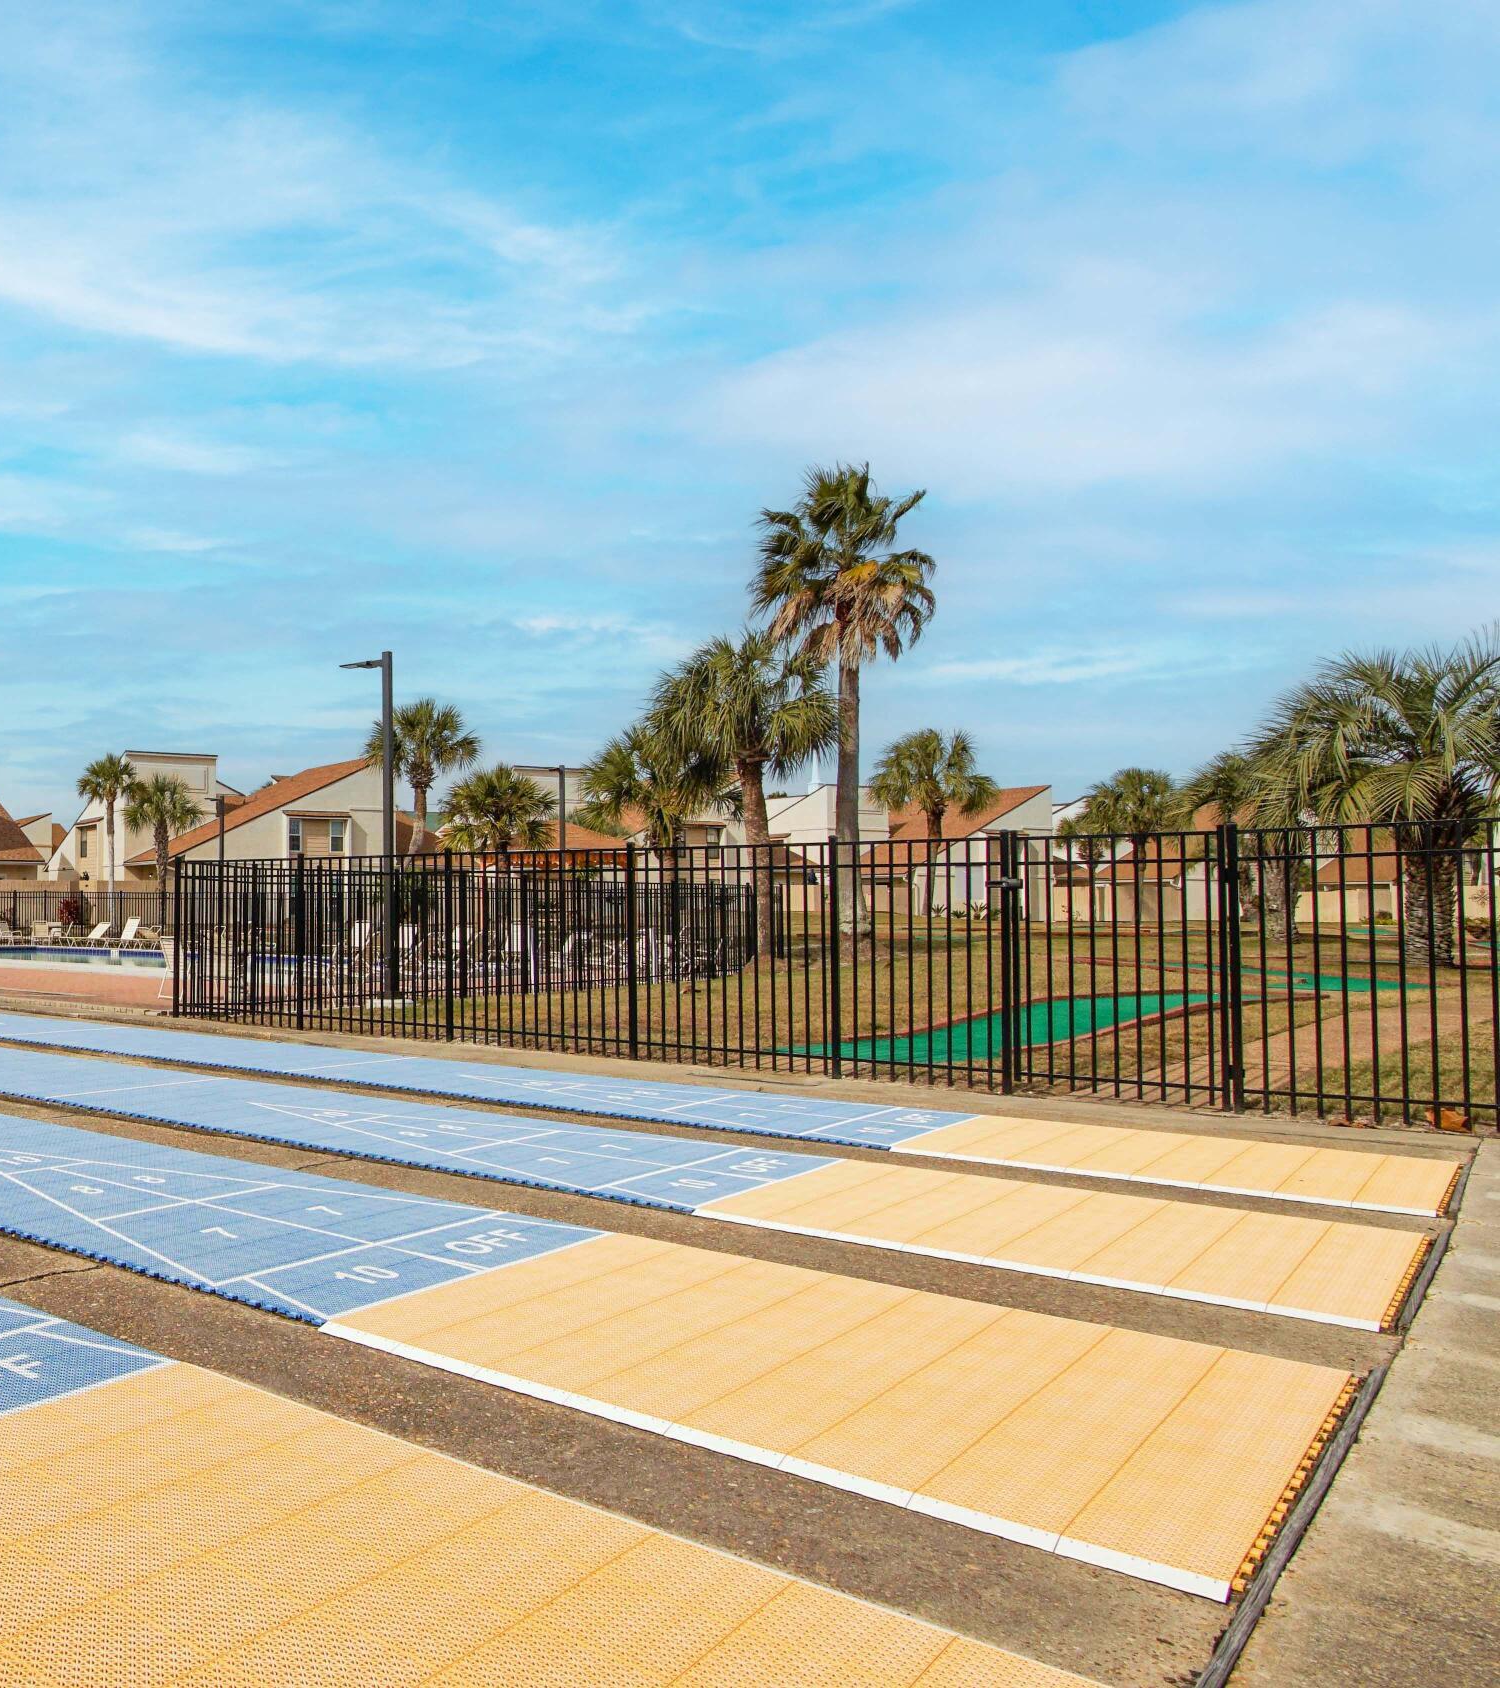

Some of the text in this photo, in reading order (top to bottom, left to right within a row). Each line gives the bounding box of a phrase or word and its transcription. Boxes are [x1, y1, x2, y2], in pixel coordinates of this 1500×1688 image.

[313, 1110, 349, 1118] 10
[538, 1157, 571, 1165] 7
[729, 1157, 788, 1173] OFF
[133, 1175, 166, 1184] 8
[668, 1178, 717, 1189] 10
[70, 1185, 104, 1195] 8
[305, 1205, 343, 1215] 7
[200, 1227, 238, 1239] 7
[444, 1228, 529, 1254] OFF
[334, 1265, 400, 1284] 10
